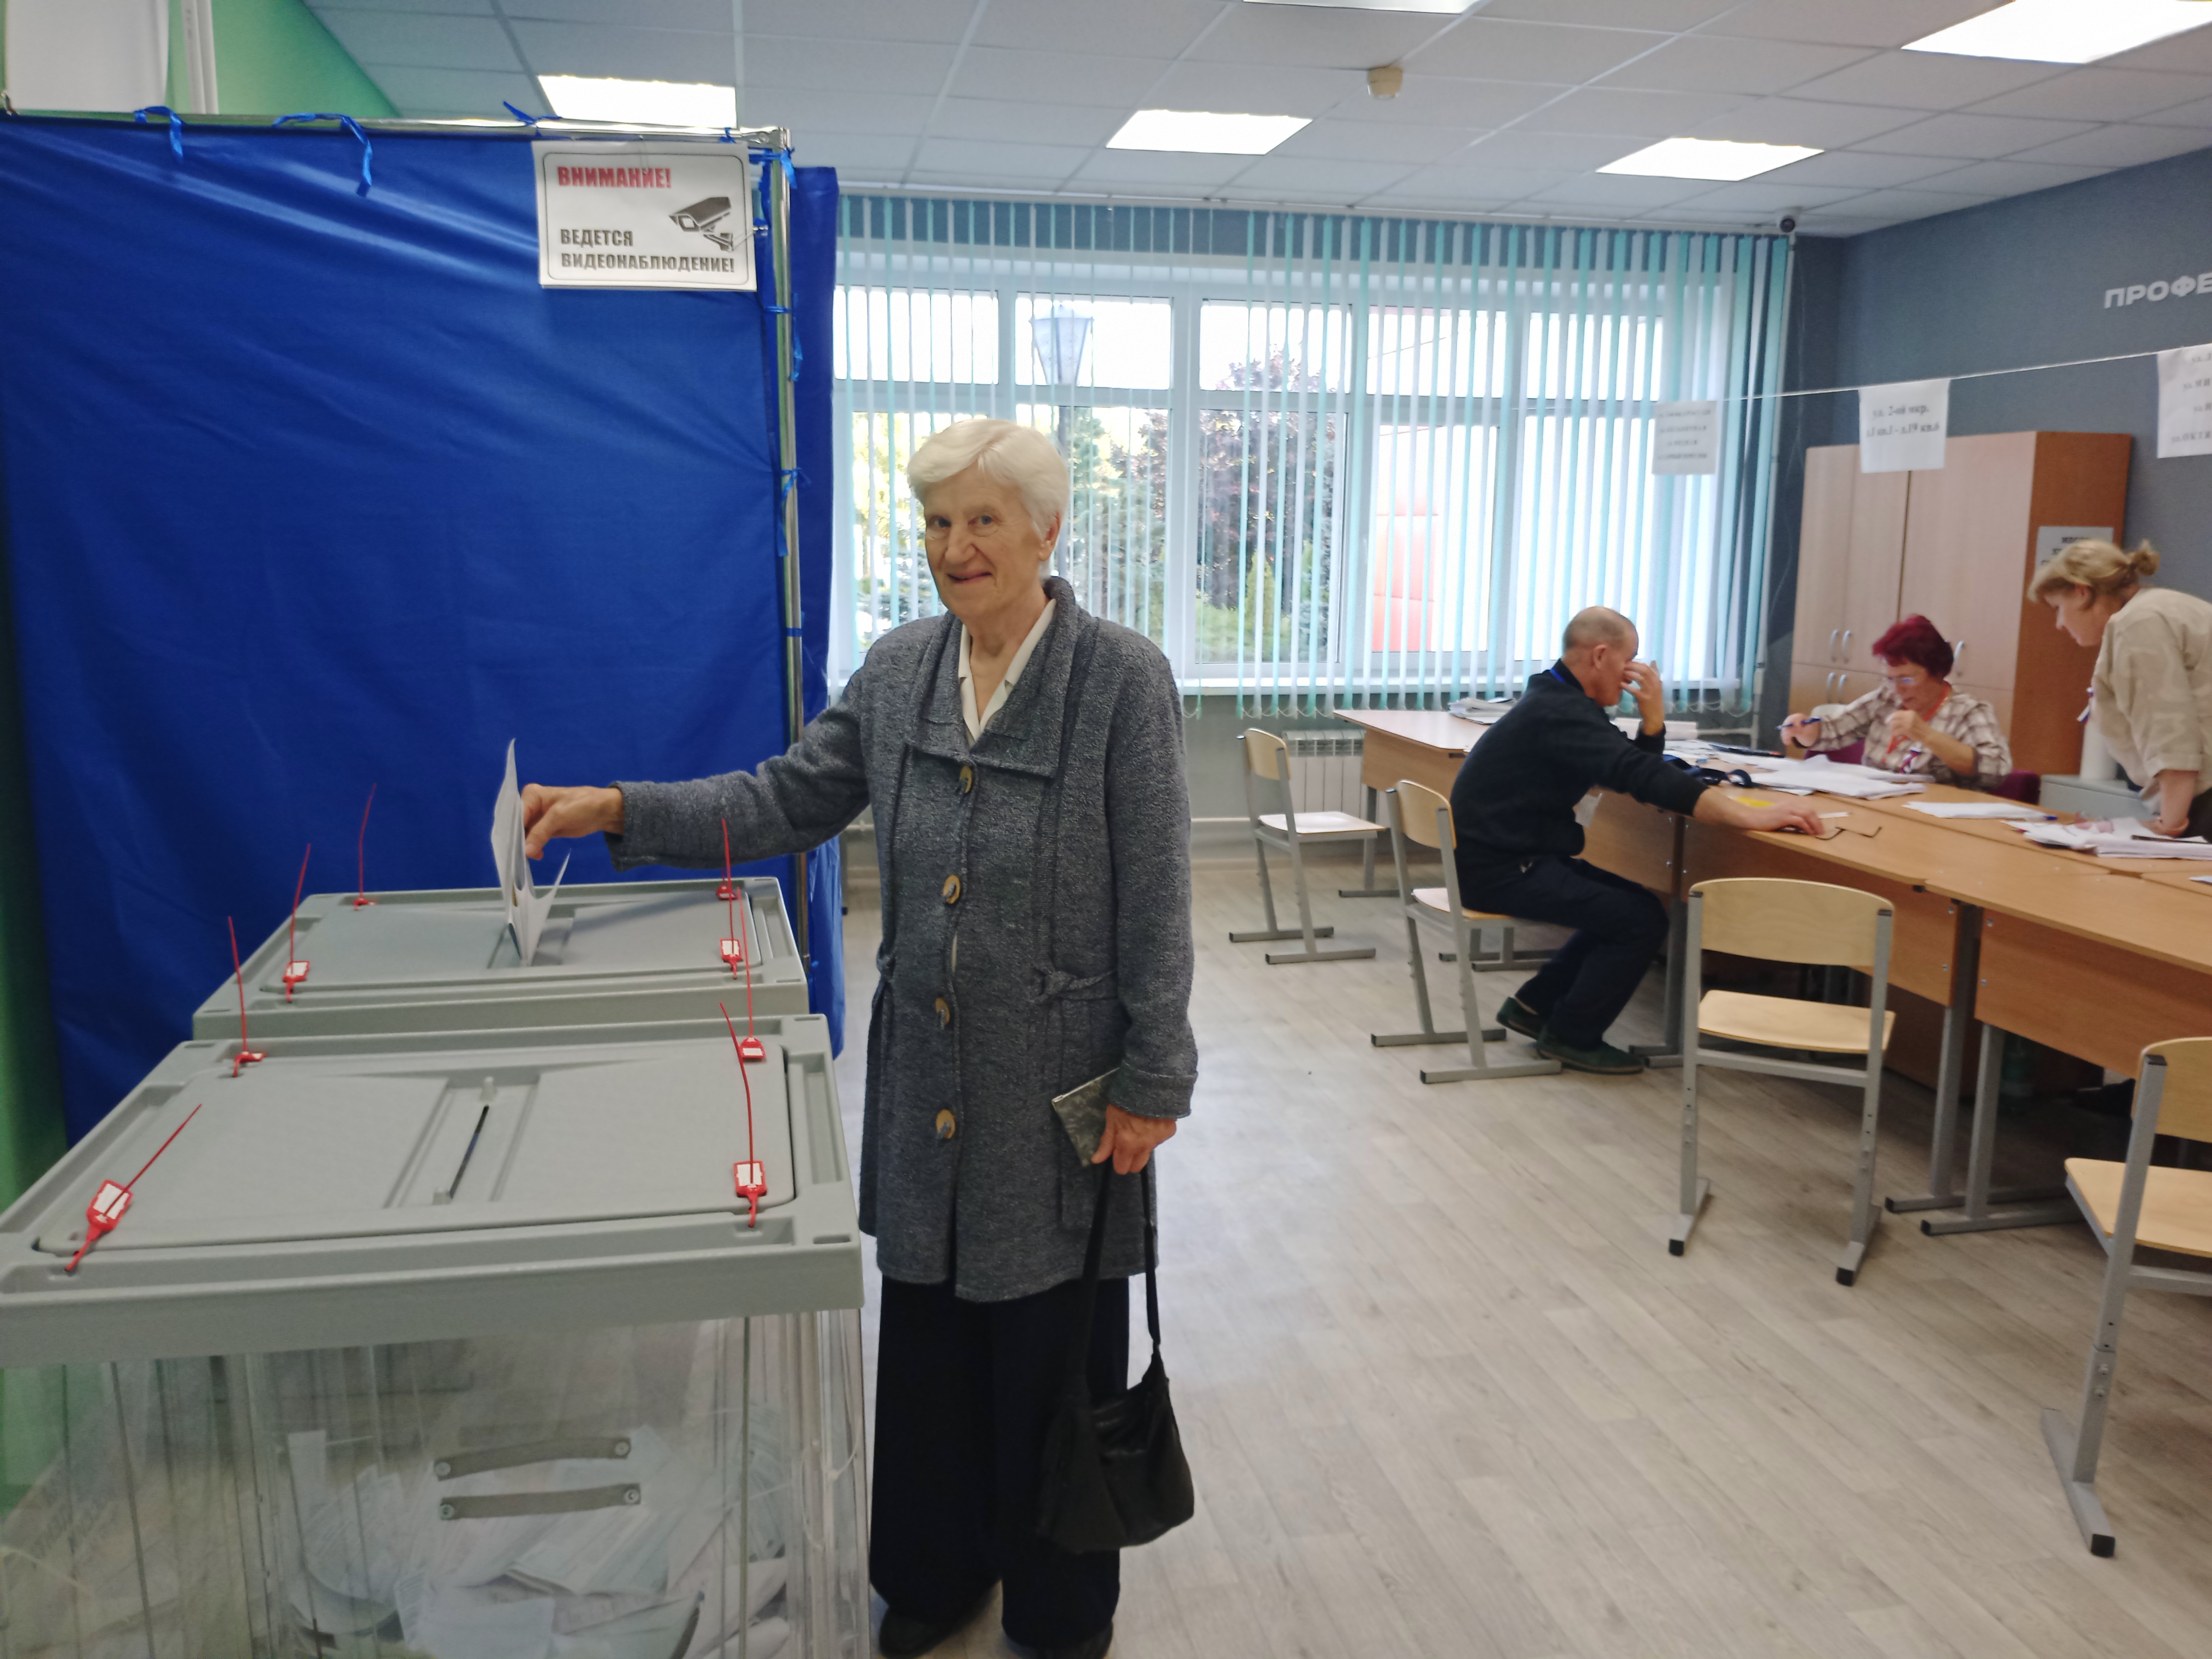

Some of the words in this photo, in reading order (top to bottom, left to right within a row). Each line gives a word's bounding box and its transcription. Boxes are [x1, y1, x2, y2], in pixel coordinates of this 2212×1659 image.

[557, 166, 671, 188] ВНИМАНИЕ!
[560, 229, 633, 248] ВЕДЕТСЯ
[561, 253, 735, 273] ВИДЕОНАБЛЮДЕНИЕ!
